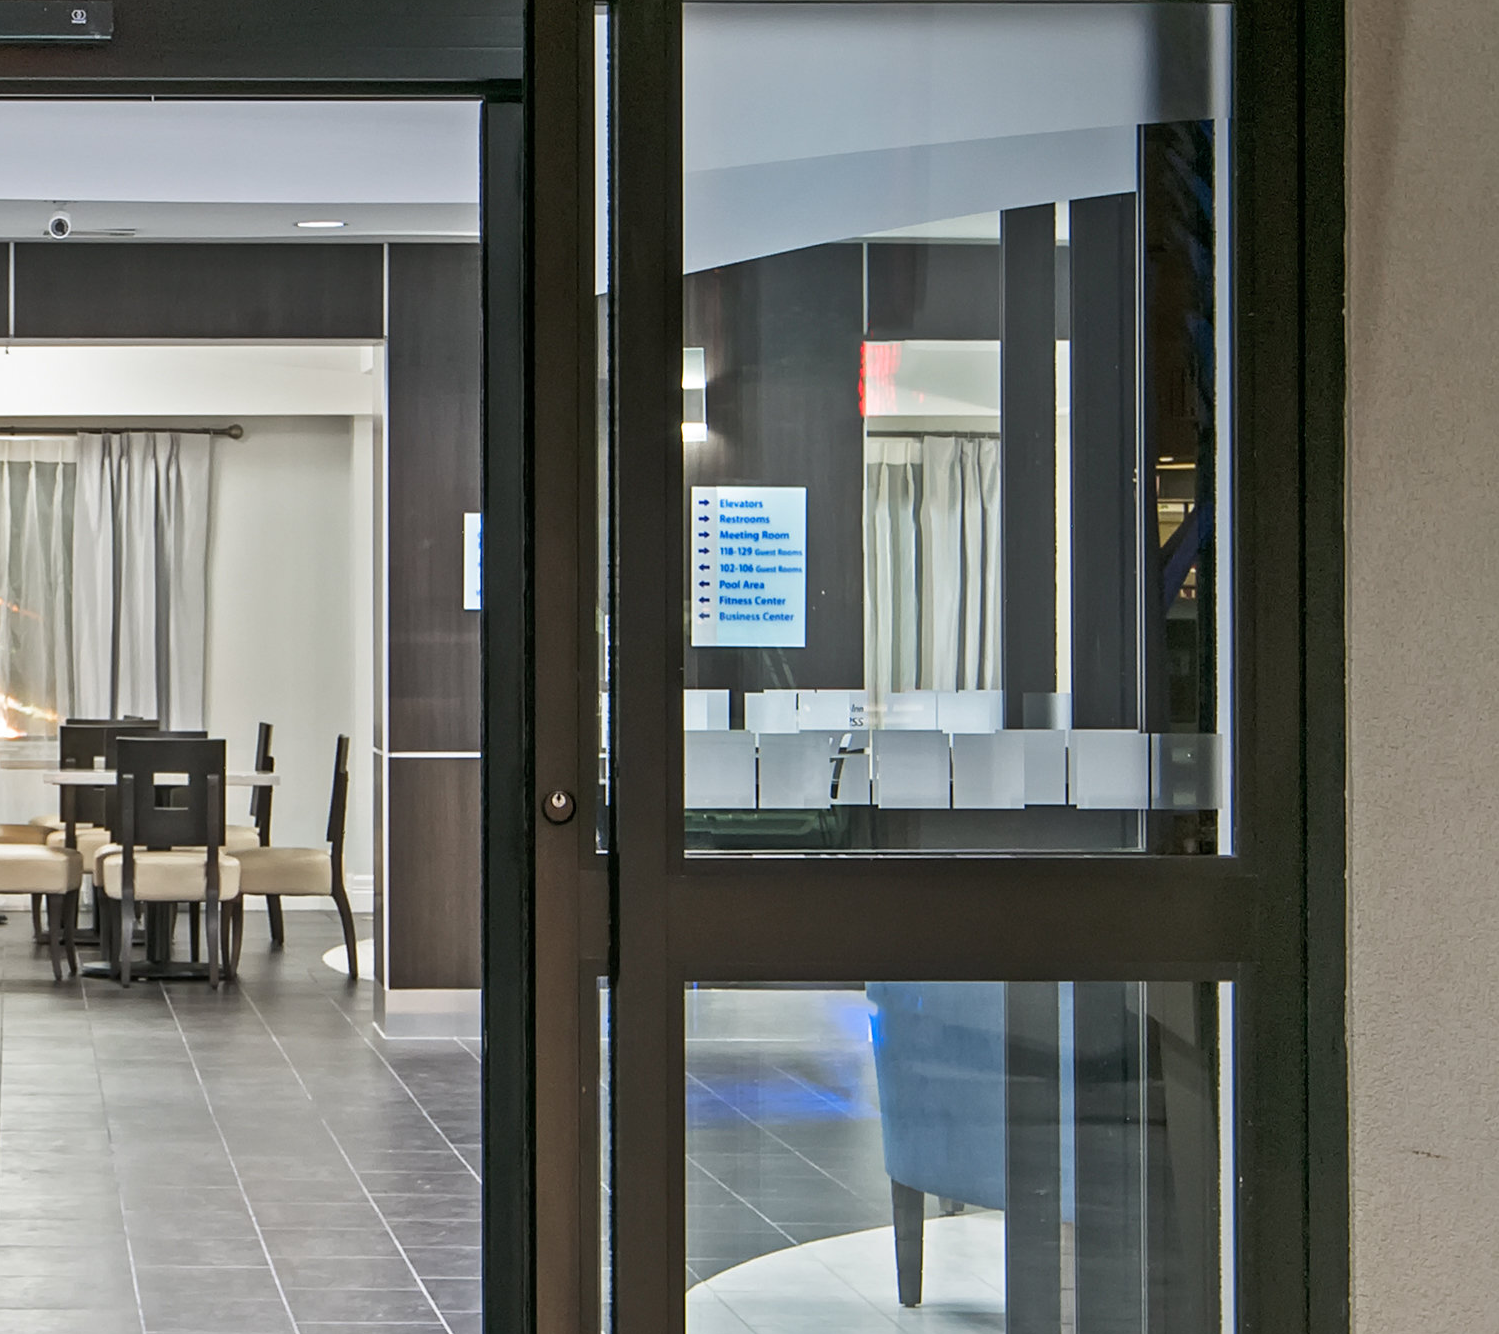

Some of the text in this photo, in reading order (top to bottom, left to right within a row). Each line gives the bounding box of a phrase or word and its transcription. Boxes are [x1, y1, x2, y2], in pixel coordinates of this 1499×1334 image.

[719, 499, 763, 508] Elevators
[719, 514, 770, 523] Restrooms
[719, 530, 790, 542] Meeting Room
[756, 565, 776, 573] Guest
[719, 580, 765, 589] Pool Area
[719, 596, 786, 605] Fitness Center
[719, 611, 794, 621] Business Center
[851, 704, 864, 713] Inn
